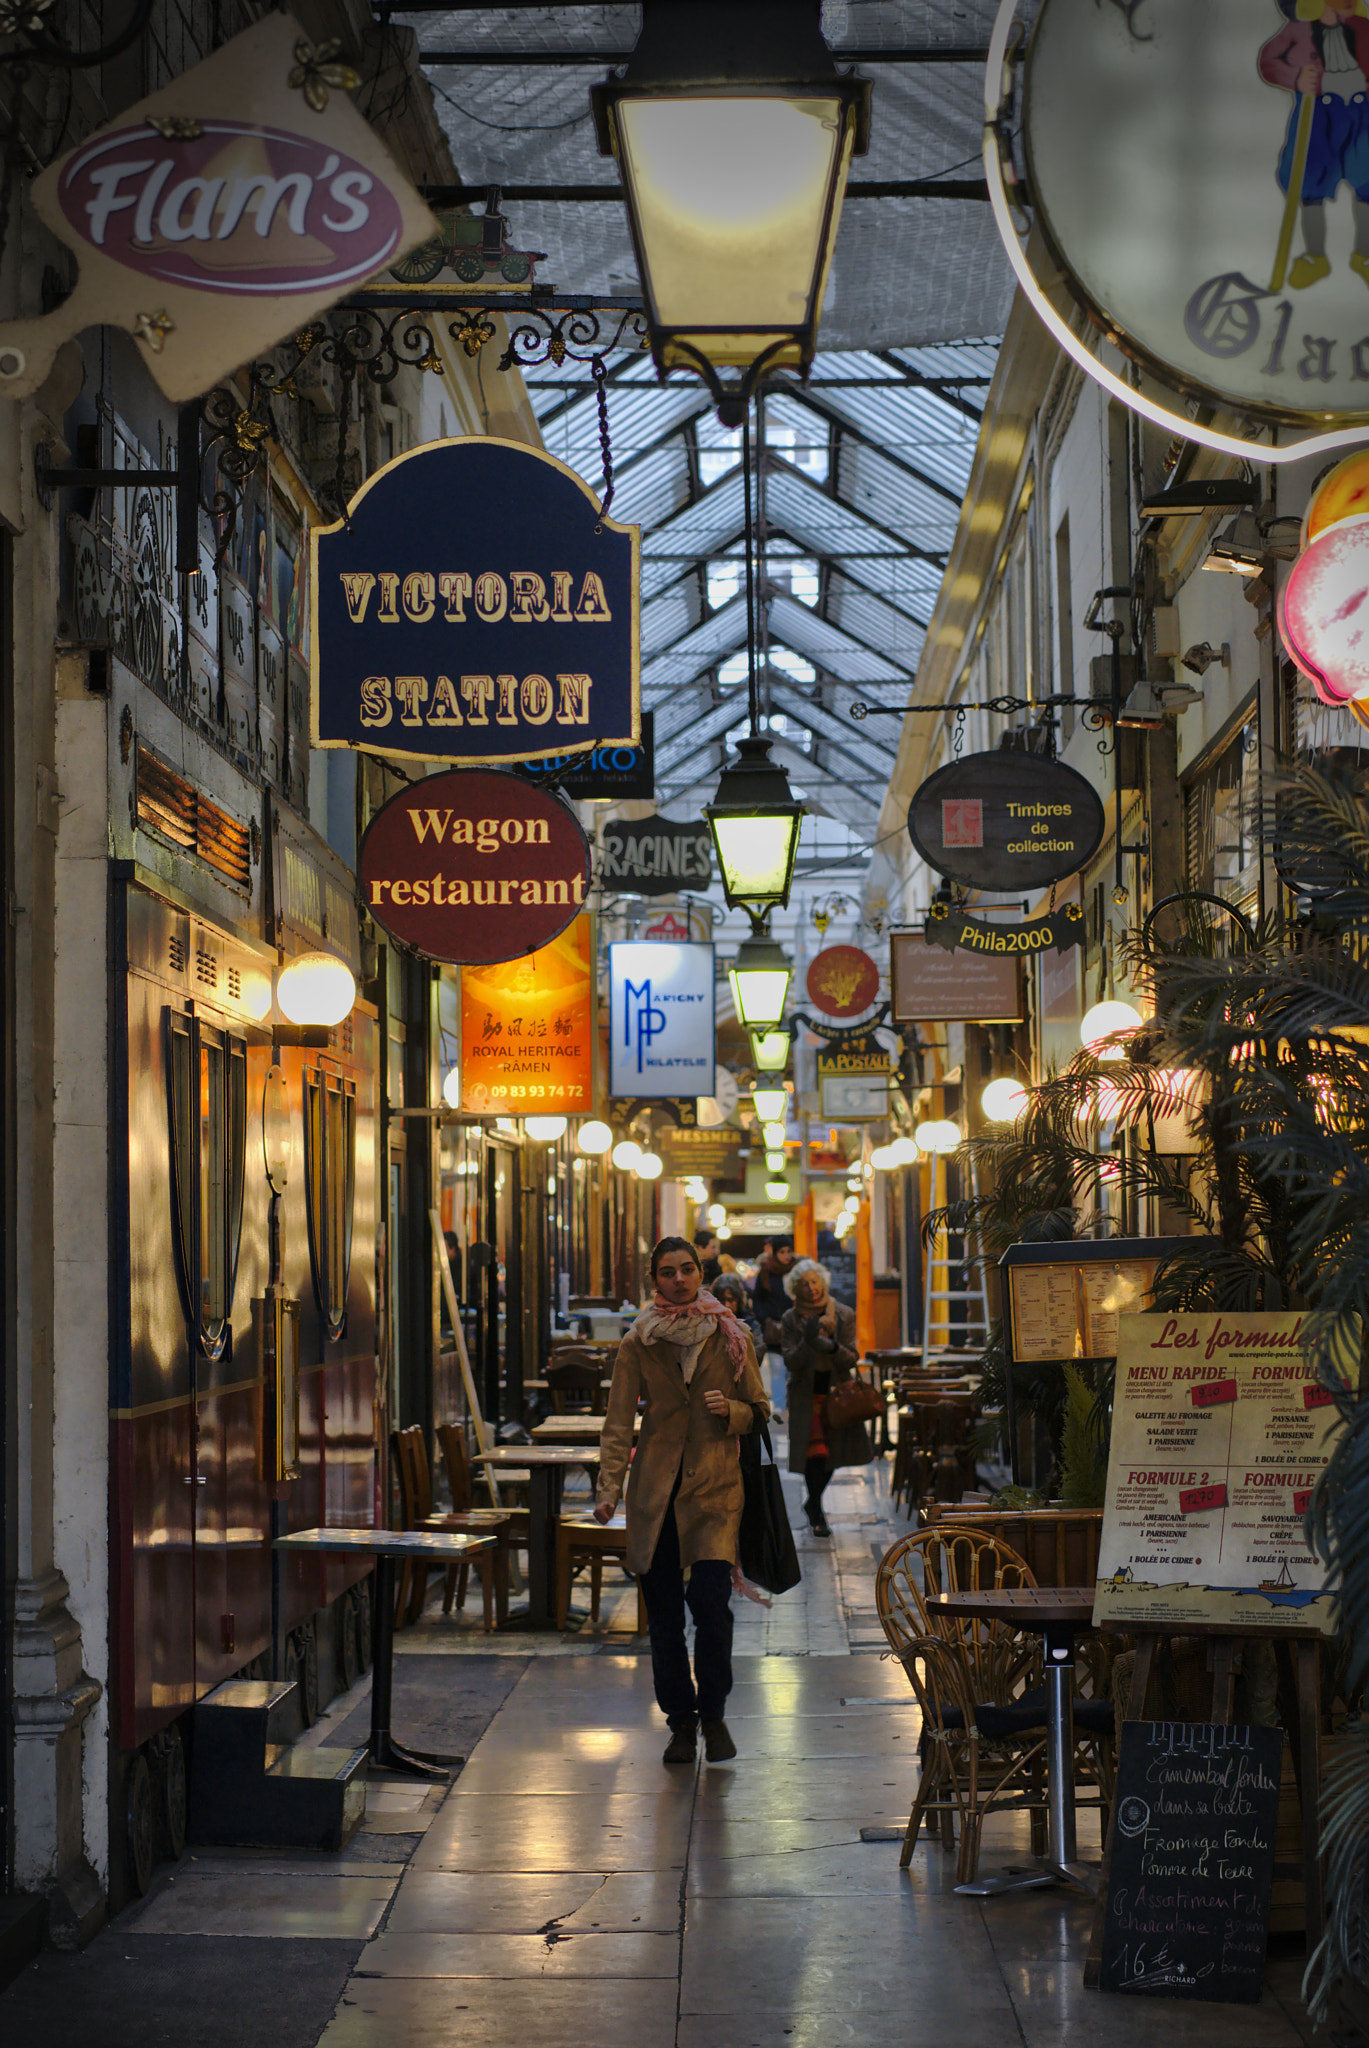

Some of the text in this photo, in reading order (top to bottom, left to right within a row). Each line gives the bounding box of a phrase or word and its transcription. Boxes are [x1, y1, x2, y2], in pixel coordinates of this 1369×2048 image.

[85, 154, 374, 244] Flam's
[340, 571, 612, 623] VICTORIA
[360, 674, 593, 727] STATION
[1006, 803, 1073, 817] Timbres
[407, 809, 550, 853] Wagon
[1031, 822, 1049, 835] de
[1007, 839, 1074, 853] collection
[605, 836, 711, 877] RACINES
[370, 872, 587, 906] restaurant
[960, 926, 1053, 951] Phila2000
[473, 1046, 581, 1057] ROYAL HERITAGE
[818, 1054, 891, 1069] LA POSTALE
[491, 1085, 584, 1097] 09 83 93 74 72
[1151, 1319, 1200, 1349] Les
[1127, 1367, 1227, 1380] MENU RAPIDE
[1178, 1412, 1213, 1420] FROMAGE
[1261, 1454, 1286, 1463] BOLÉE
[1127, 1471, 1209, 1485] FORMULE 2
[1244, 1473, 1315, 1487] FORMULE
[1135, 1554, 1158, 1563] BOLÉE
[1252, 1554, 1277, 1563] BOLÉE
[1154, 1788, 1193, 1815] dans
[1143, 1826, 1268, 1860] Fromage Fondu
[1140, 1853, 1255, 1880] Pomme de Terre
[1134, 1884, 1244, 1913] Assortiment
[1164, 1975, 1197, 1985] RICHARD
